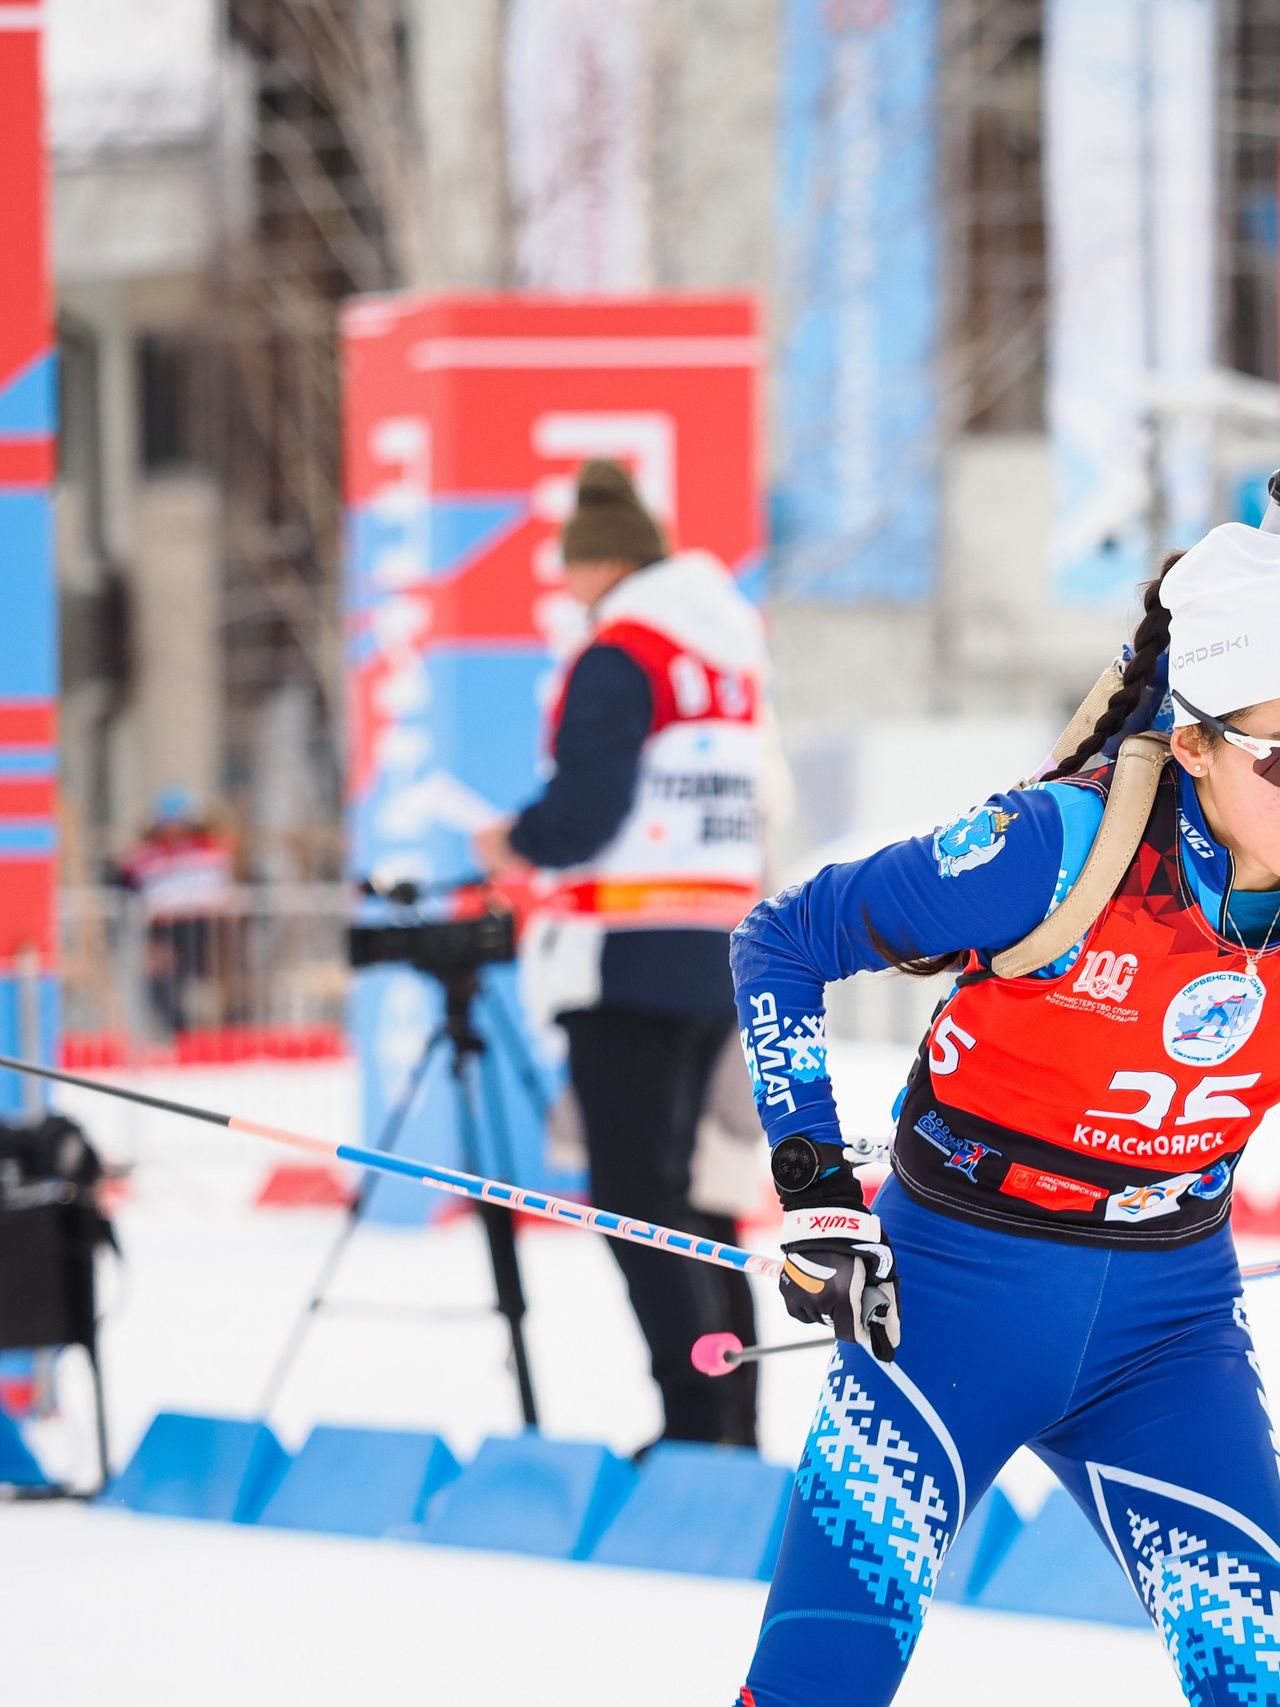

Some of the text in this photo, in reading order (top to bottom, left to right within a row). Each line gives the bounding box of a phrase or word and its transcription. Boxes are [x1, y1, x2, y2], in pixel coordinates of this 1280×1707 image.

[1171, 634, 1249, 672] NORDSKI
[1182, 973, 1247, 997] ПЕРВЕНСТВО
[1053, 992, 1111, 1012] МИНИСТЕРСТВО
[1112, 1006, 1139, 1016] СПОРТА
[749, 992, 797, 1114] ЯМАЛ
[1035, 1180, 1058, 1193] КРАЙ
[1038, 1175, 1102, 1199] КРАСНОЯРСКИЙ
